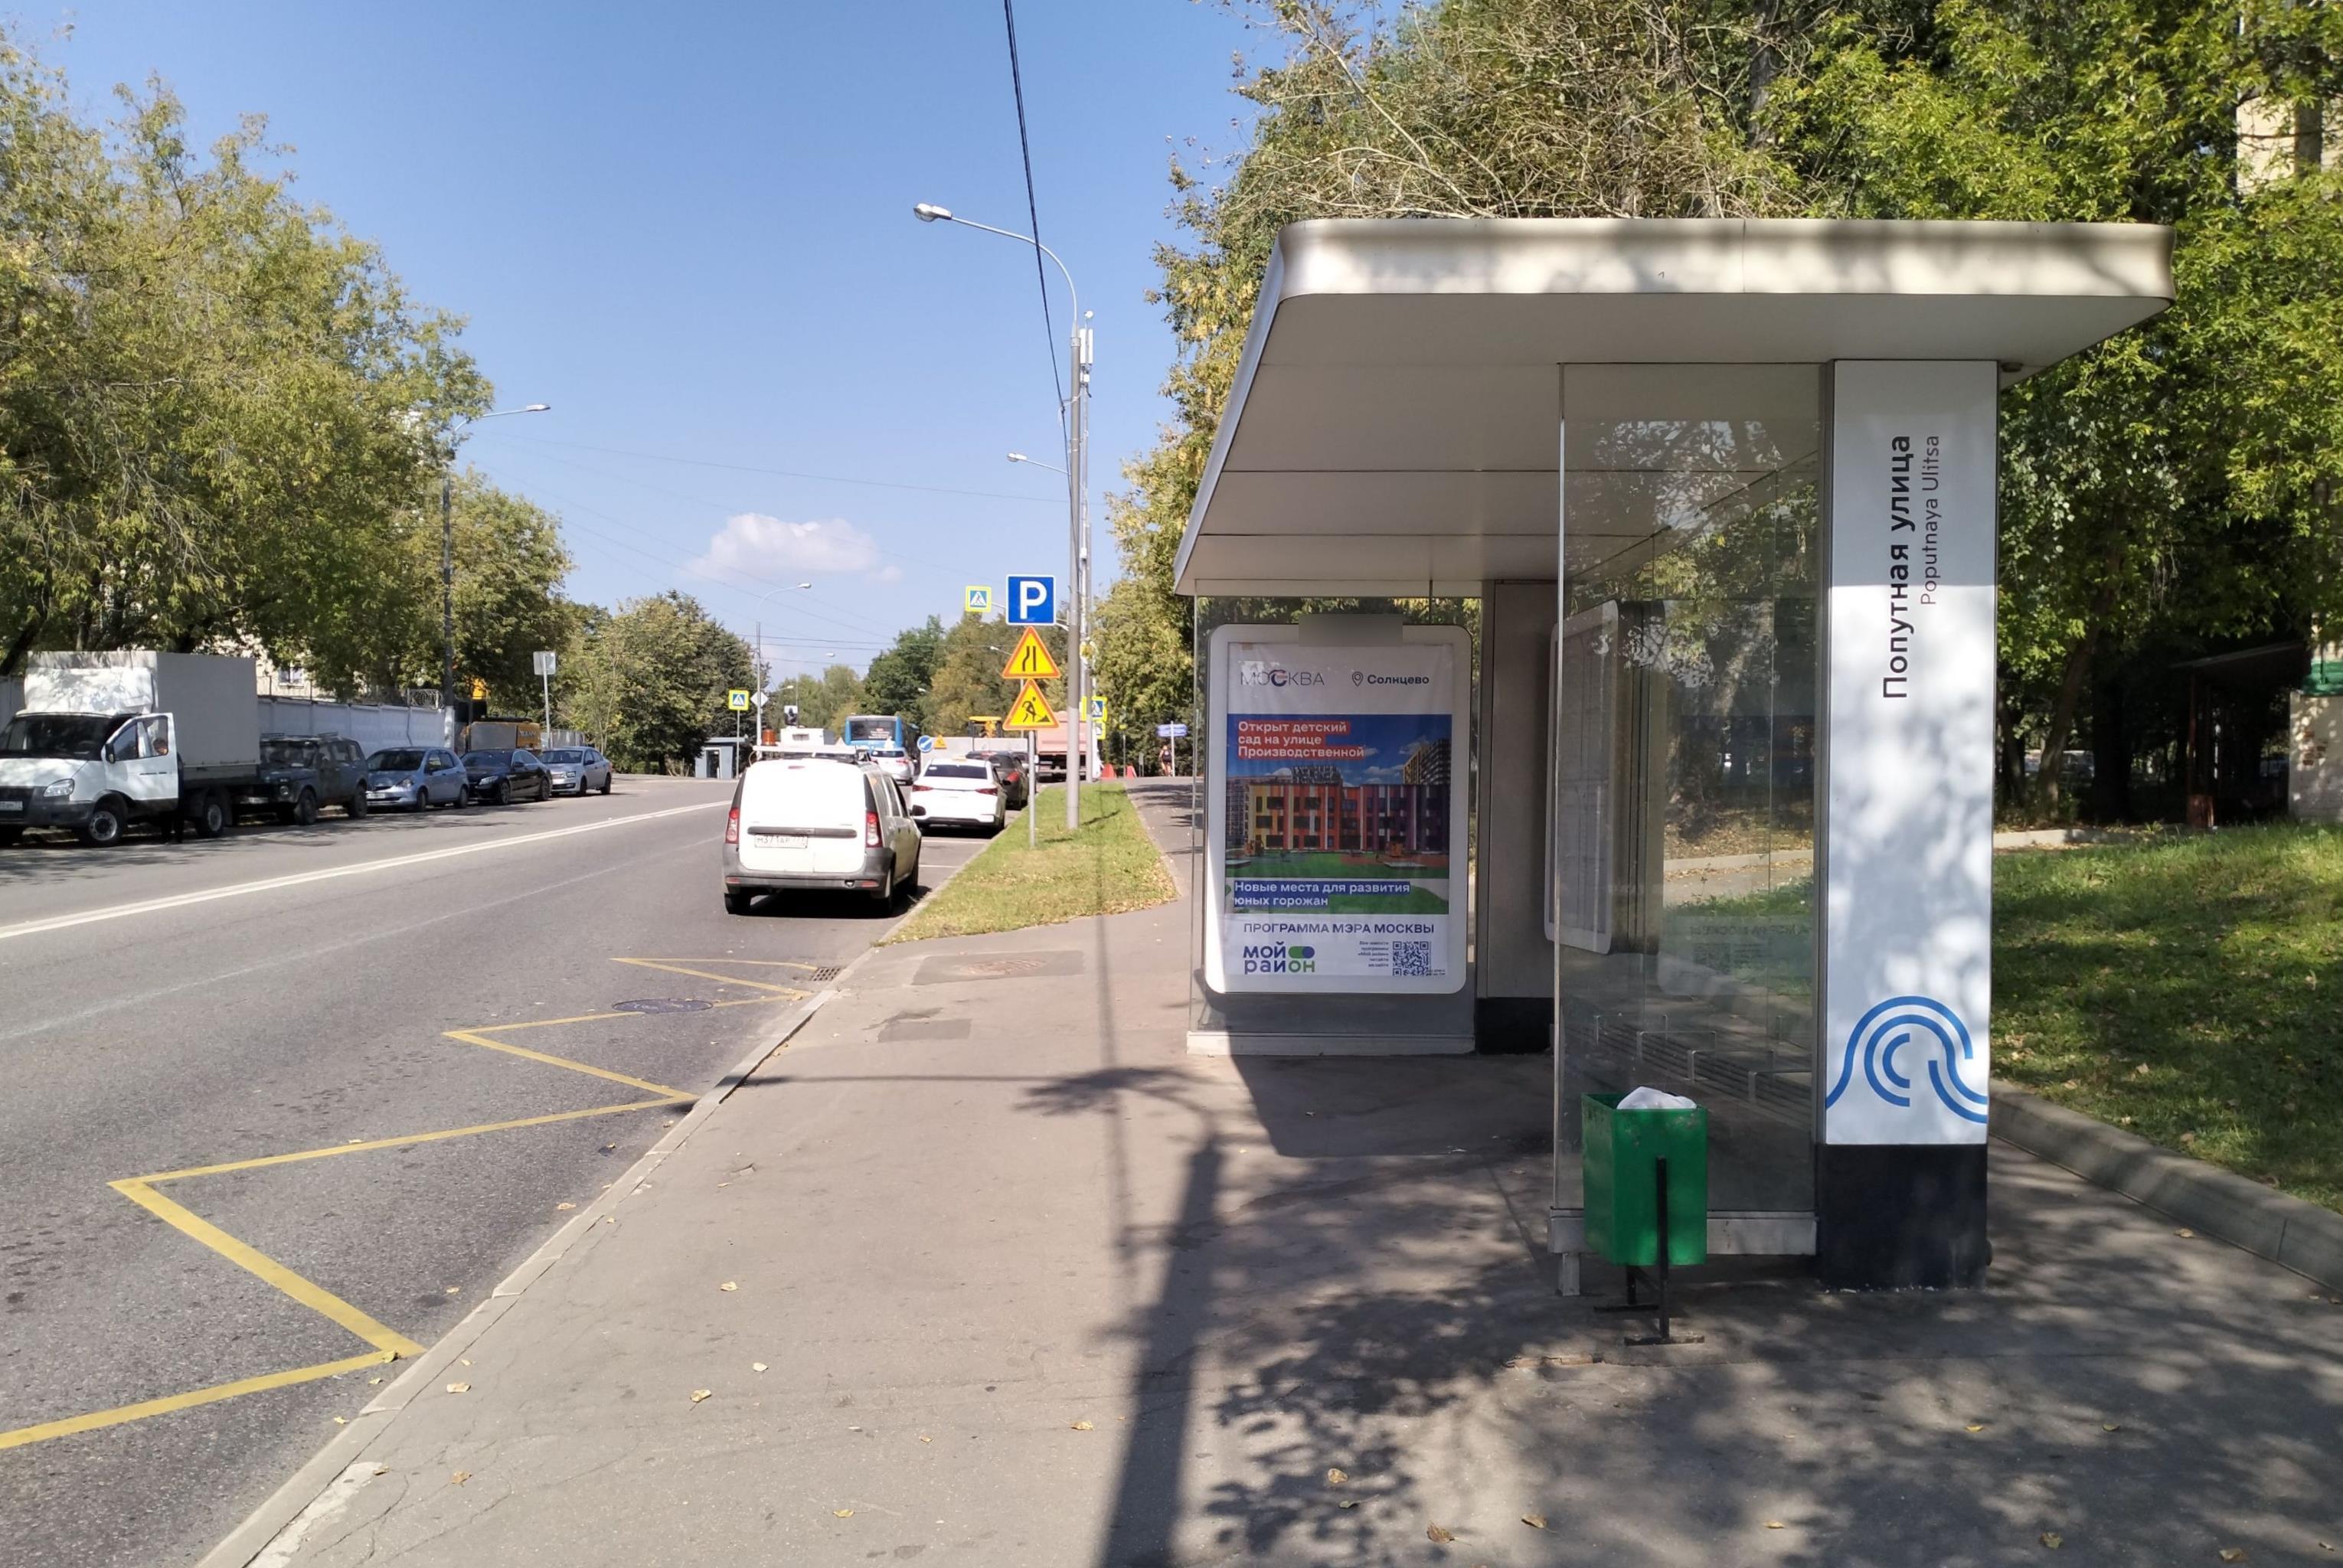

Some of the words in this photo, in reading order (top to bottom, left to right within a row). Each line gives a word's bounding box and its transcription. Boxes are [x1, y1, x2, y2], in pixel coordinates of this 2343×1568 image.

[1921, 435, 1939, 492] Ulitsa
[1891, 436, 1915, 531] улица
[1920, 498, 1942, 605] Poputnaya
[1020, 580, 1047, 619] P
[1883, 544, 1914, 698] Попутная
[1240, 669, 1325, 687] МОСКВА
[1368, 674, 1430, 685] Солнцево
[1238, 721, 1289, 734] Открыт
[1292, 721, 1347, 733] детский
[1238, 736, 1262, 746] сад
[1265, 736, 1279, 744] на
[1283, 736, 1322, 746] улице
[1238, 746, 1364, 758] Производственной
[1234, 881, 1277, 892] Новые
[1281, 884, 1319, 892] места
[1322, 884, 1346, 893] для
[1349, 884, 1410, 894] развития
[1235, 897, 1270, 906] юных
[1273, 897, 1328, 908] горожан
[1243, 923, 1329, 933] ПРОГРАММА
[1332, 923, 1371, 933] МЭРА
[1374, 923, 1434, 933] МОСКВЫ
[1243, 941, 1286, 959] мой
